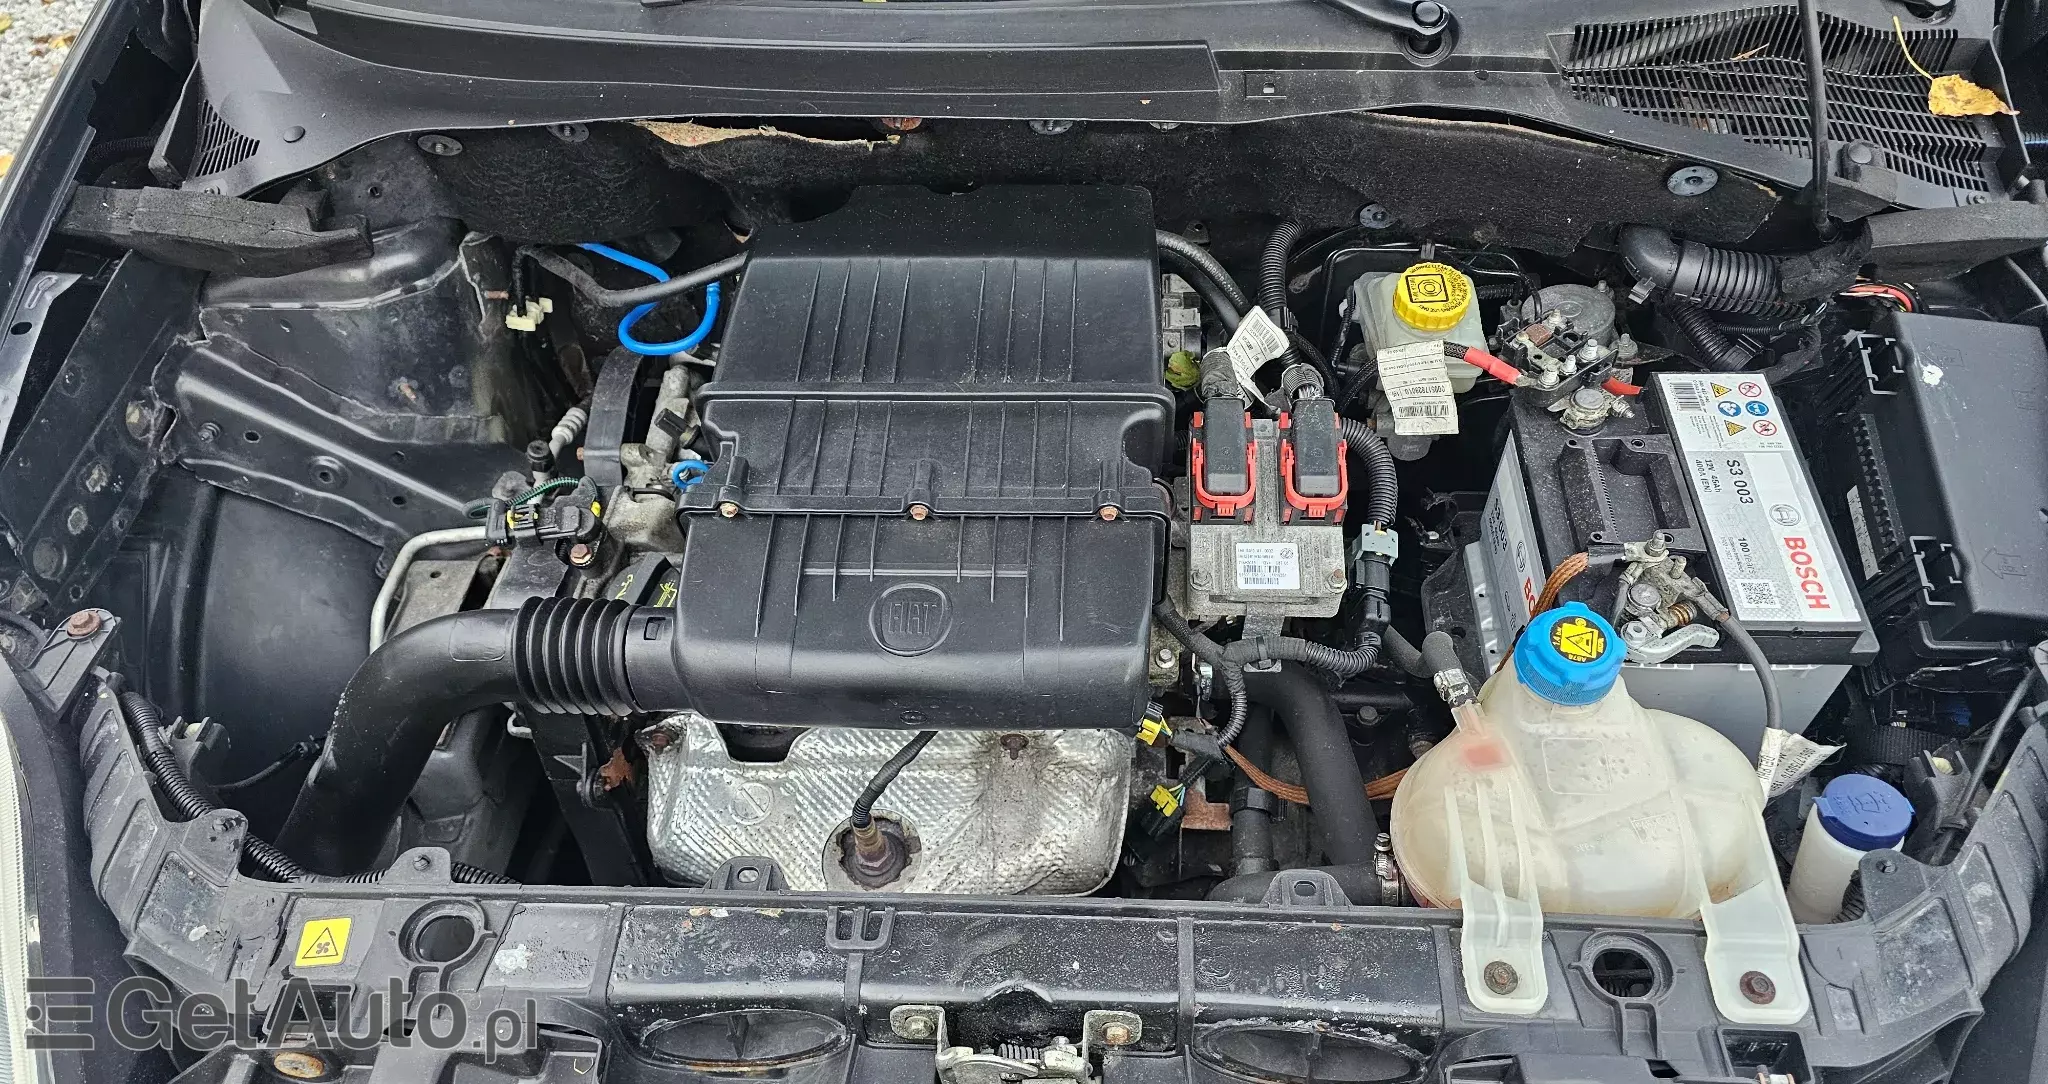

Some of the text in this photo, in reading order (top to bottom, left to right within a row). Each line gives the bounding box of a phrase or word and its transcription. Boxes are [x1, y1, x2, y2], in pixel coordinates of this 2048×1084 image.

[1704, 459, 1716, 472] 12V
[1726, 459, 1754, 504] S3 003
[1738, 537, 1750, 553] 100
[1783, 536, 1831, 610] BOSCH
[887, 601, 938, 636] FIAT
